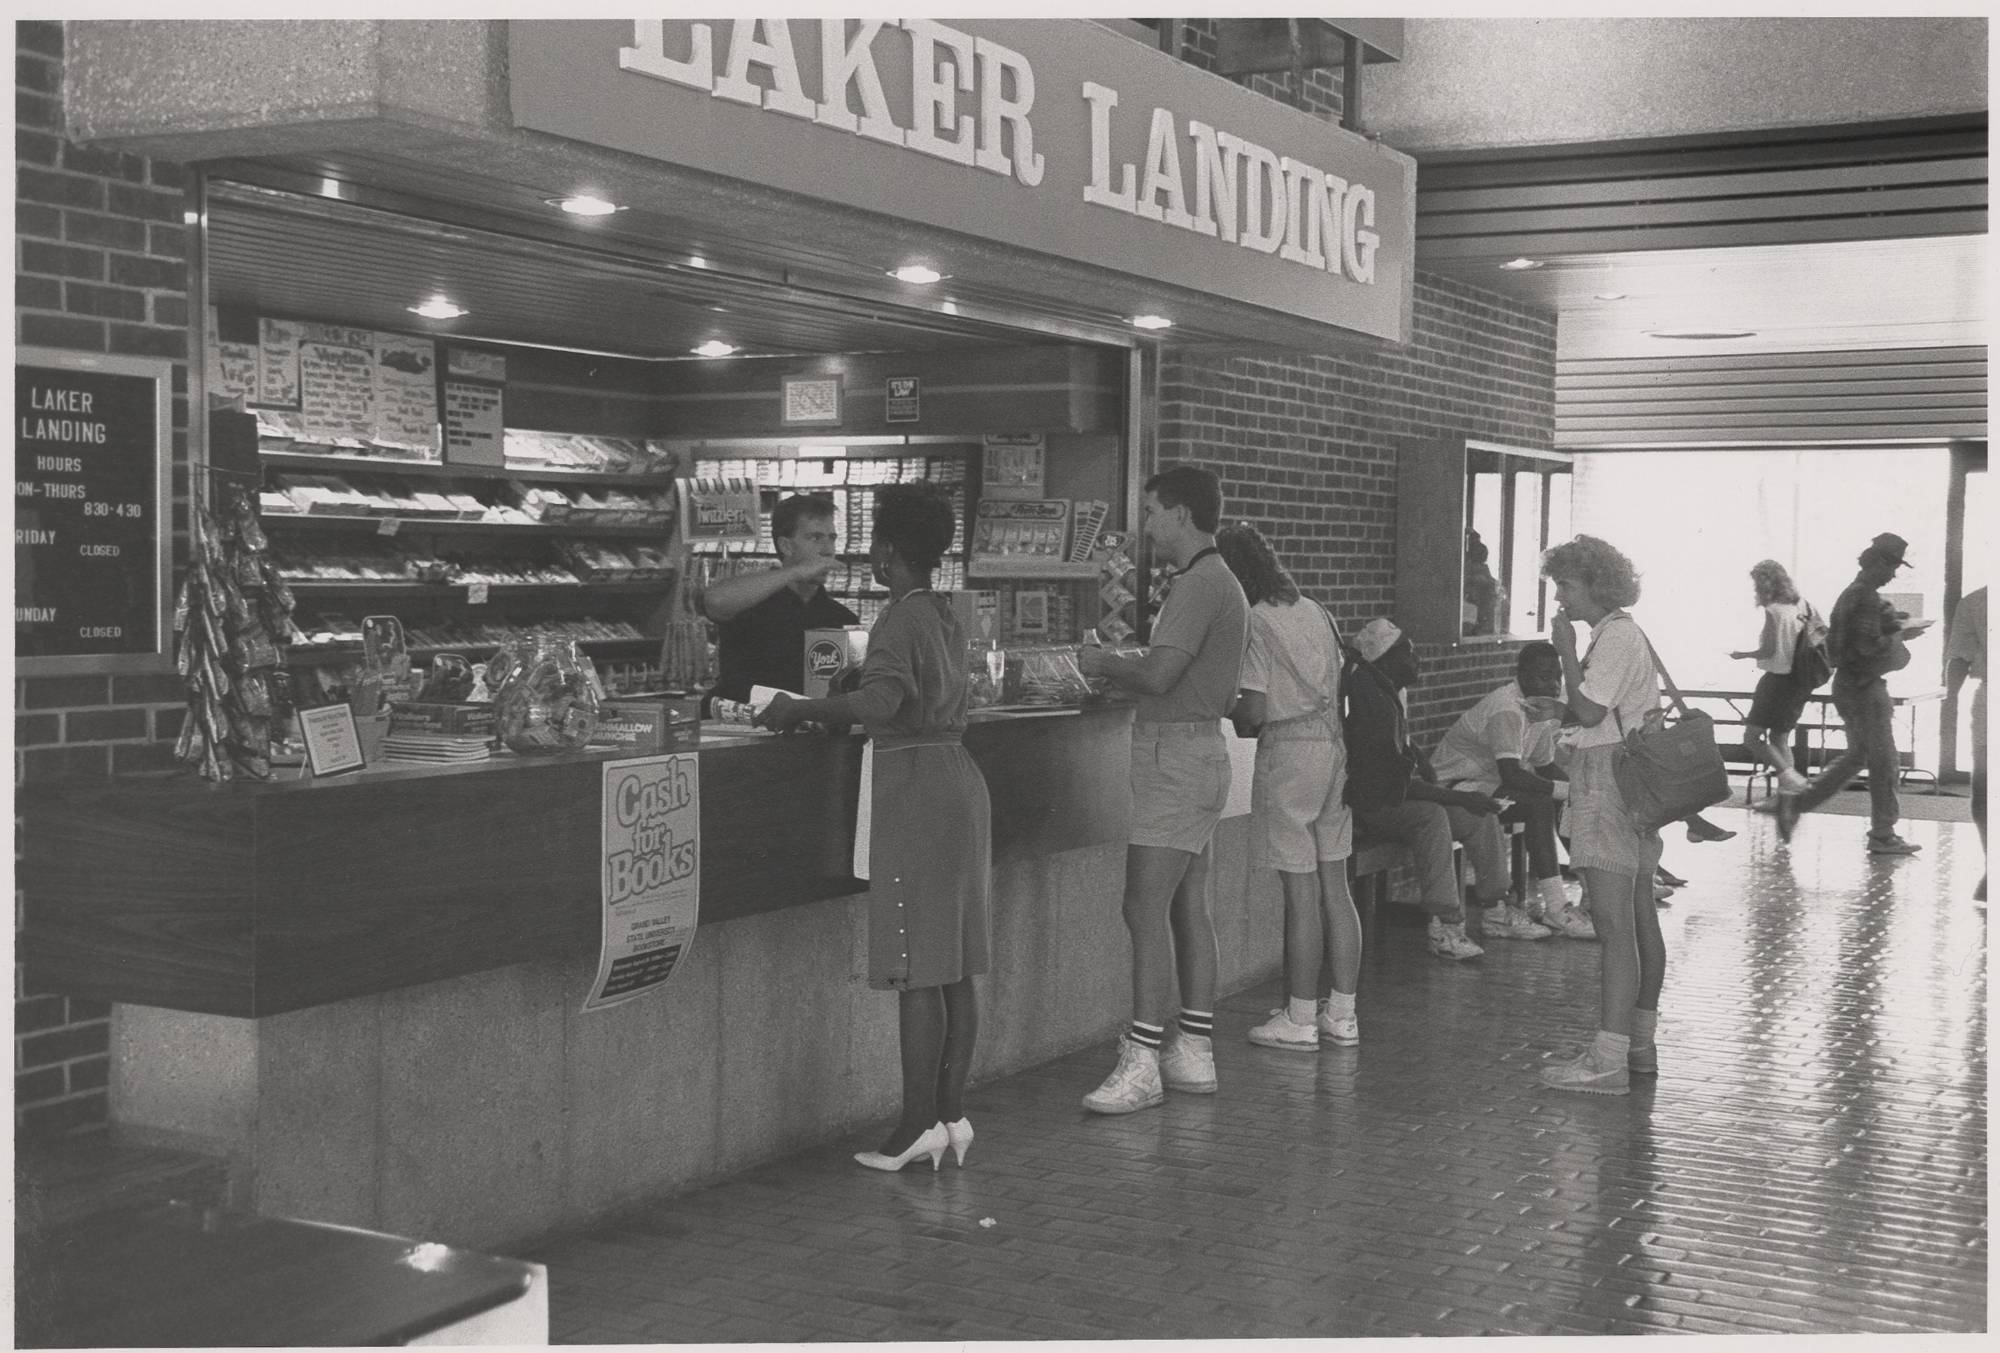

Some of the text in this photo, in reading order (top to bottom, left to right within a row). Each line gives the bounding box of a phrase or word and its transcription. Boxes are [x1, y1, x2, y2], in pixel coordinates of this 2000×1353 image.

[1082, 81, 1380, 285] LANDING
[31, 387, 93, 414] LAKER
[22, 417, 106, 444] LANDING
[36, 455, 82, 472] HOURS
[15, 481, 87, 499] ON-THURS
[16, 530, 57, 545] RIDAY
[80, 545, 121, 557] CLOSED
[16, 607, 57, 623] UNDAY
[80, 626, 122, 638] CLOSED
[811, 649, 840, 671] York
[616, 756, 690, 827] Cash
[632, 819, 670, 858] for
[609, 830, 695, 905] Books
